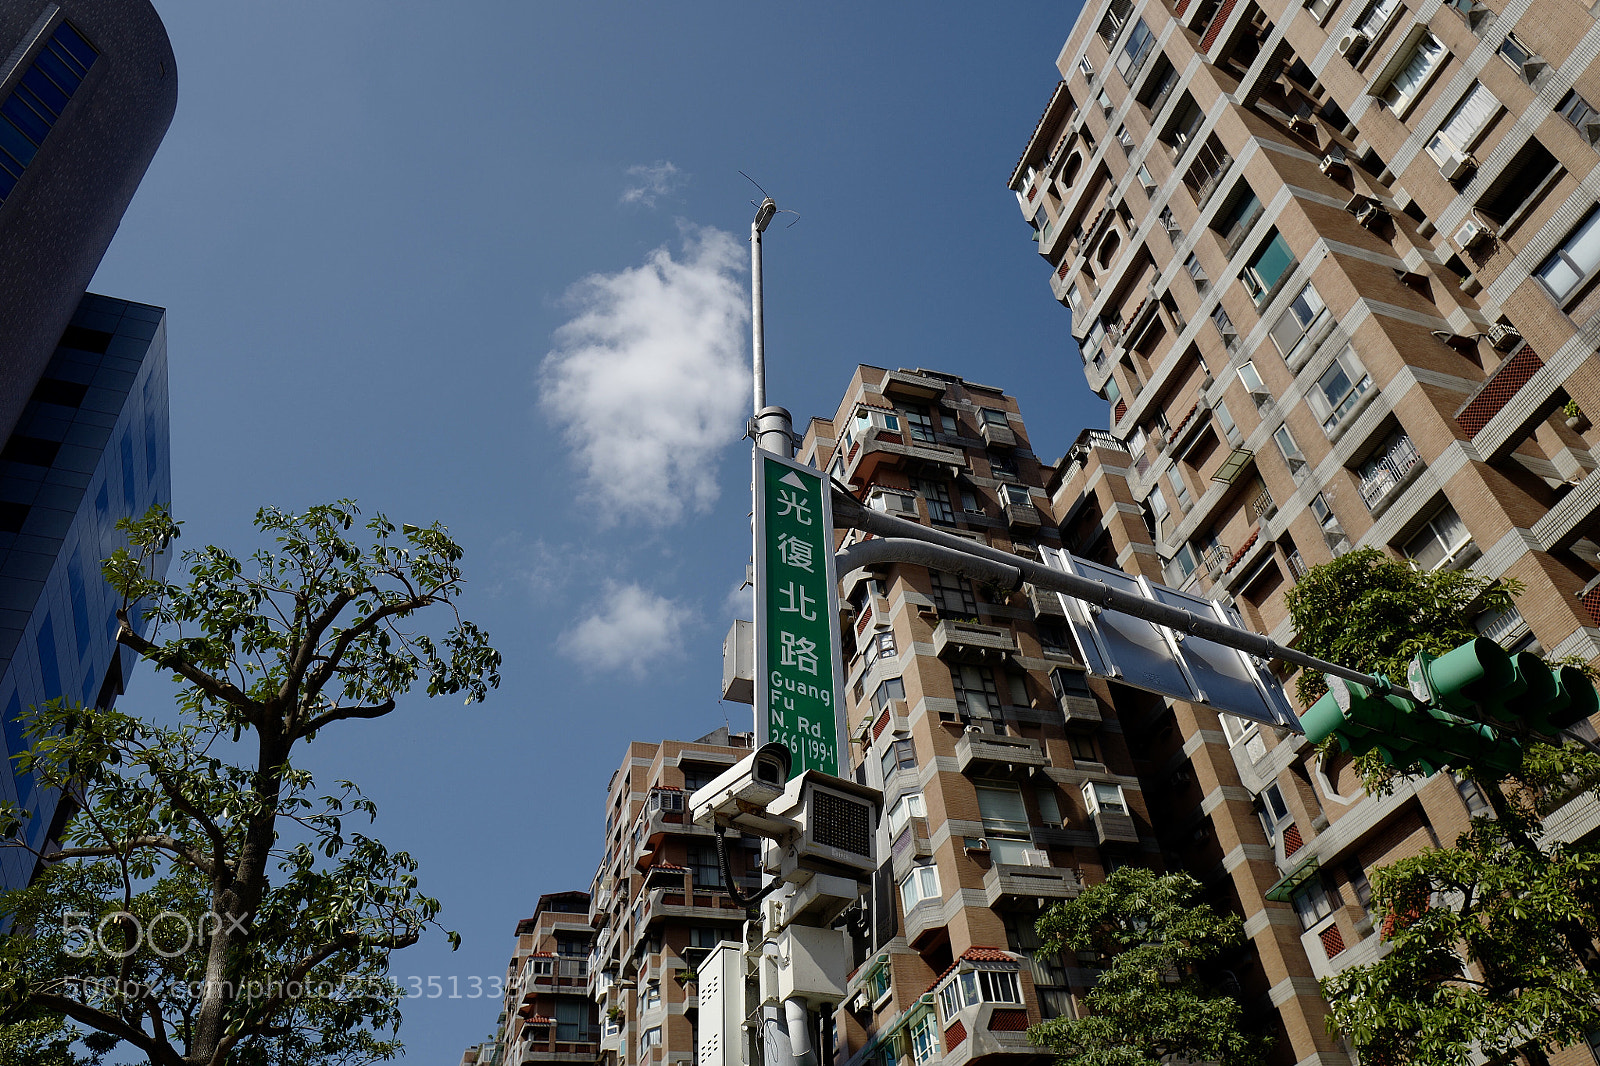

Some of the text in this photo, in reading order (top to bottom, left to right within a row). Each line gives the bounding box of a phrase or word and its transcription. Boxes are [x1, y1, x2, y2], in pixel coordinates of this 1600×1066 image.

[777, 489, 818, 676] 光復北路
[771, 670, 830, 707] Guang
[771, 688, 794, 711] Fu
[771, 708, 826, 740] N. Rd.
